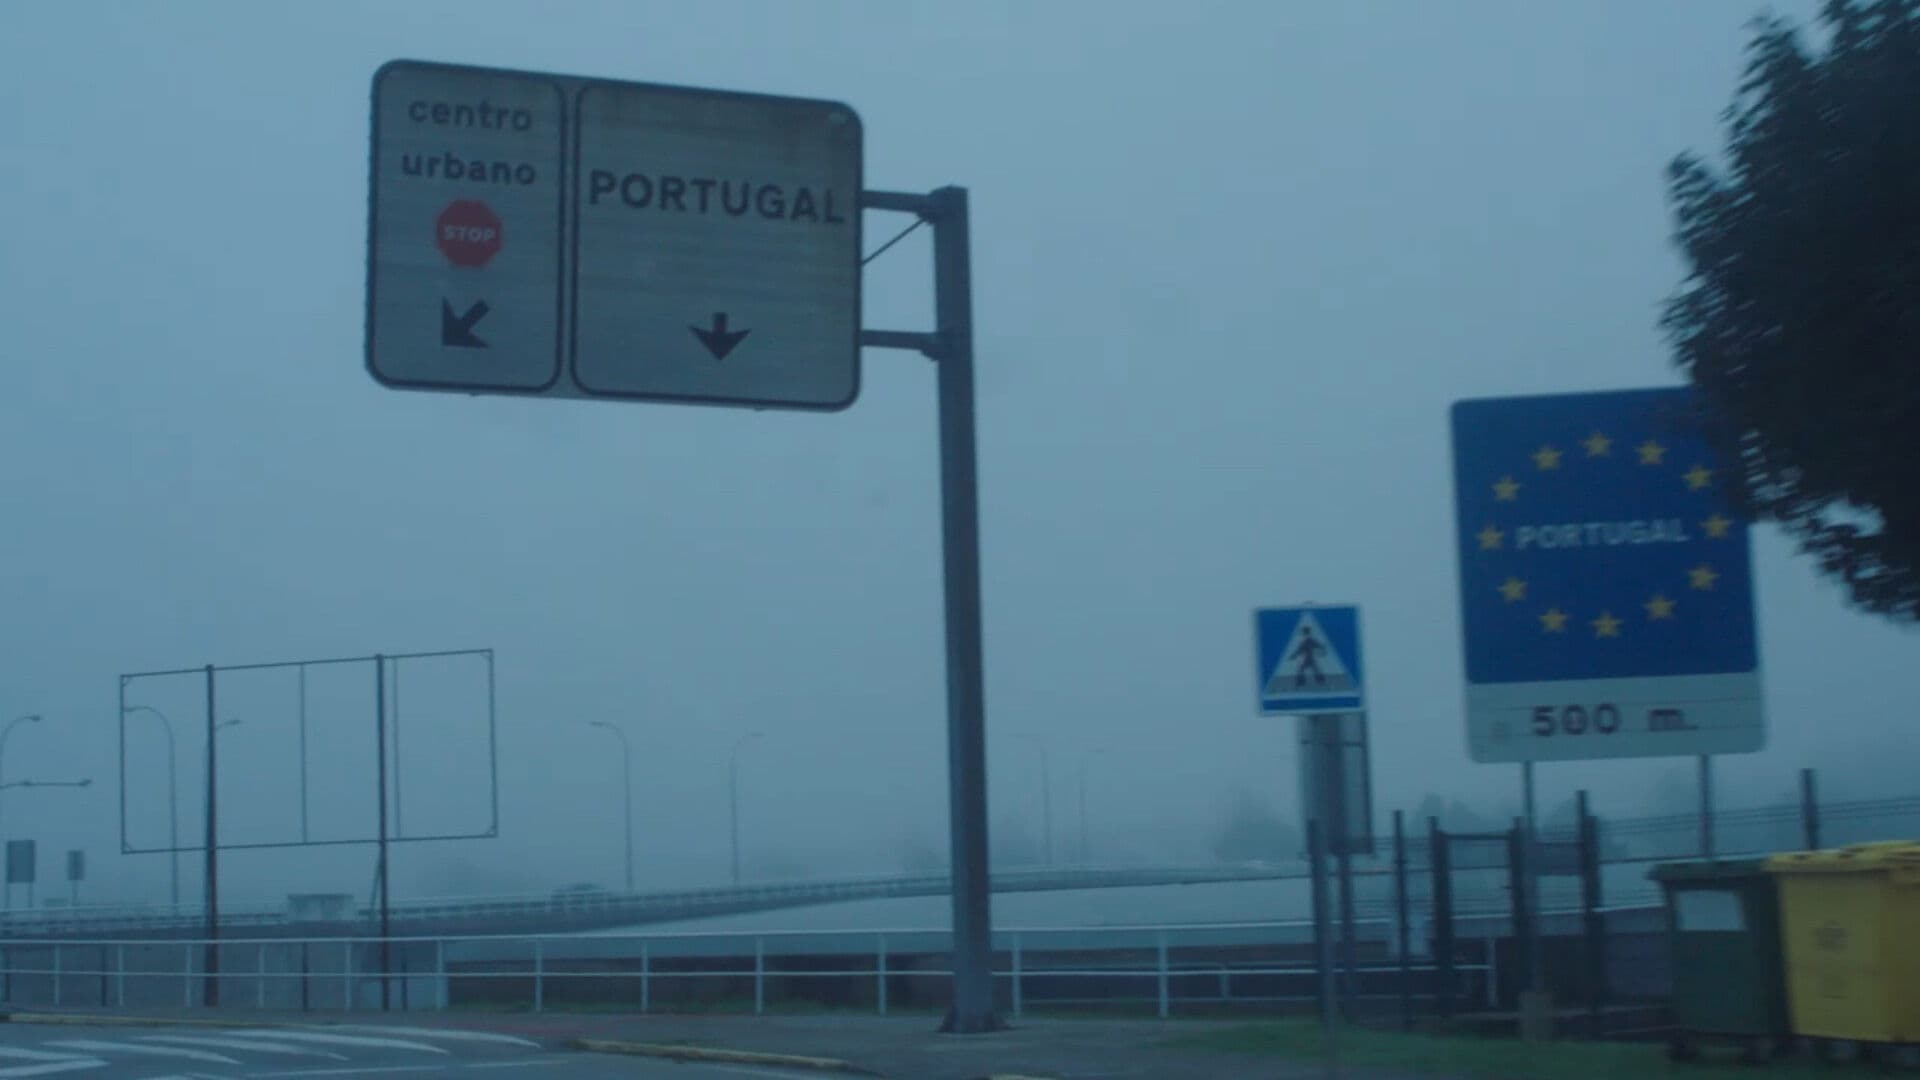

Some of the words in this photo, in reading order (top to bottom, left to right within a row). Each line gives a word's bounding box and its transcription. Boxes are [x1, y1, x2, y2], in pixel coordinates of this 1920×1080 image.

[409, 98, 532, 131] centro
[402, 151, 536, 186] urbano
[588, 168, 846, 224] PORTUGAL
[443, 224, 496, 243] STOP
[1516, 518, 1689, 549] PORTUGAL
[1532, 703, 1622, 736] 500
